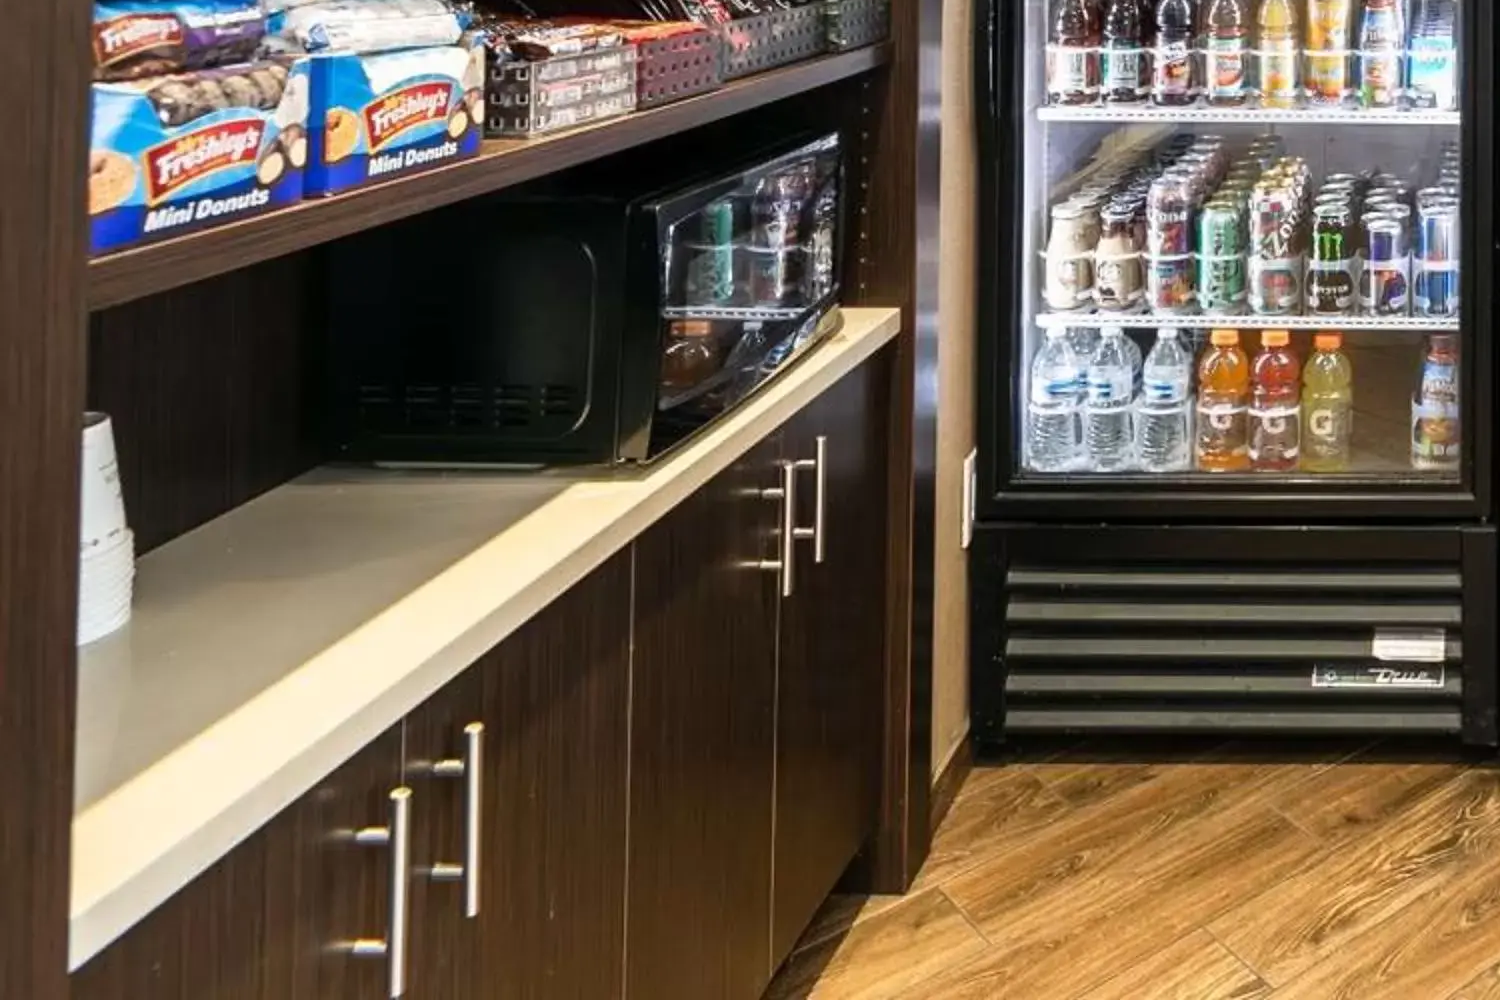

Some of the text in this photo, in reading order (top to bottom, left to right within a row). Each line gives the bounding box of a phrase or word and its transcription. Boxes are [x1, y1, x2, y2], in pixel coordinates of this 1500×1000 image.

[368, 140, 458, 177] Mini Donuts
[143, 188, 270, 233] Mini Donuts
[1310, 409, 1333, 435] G
